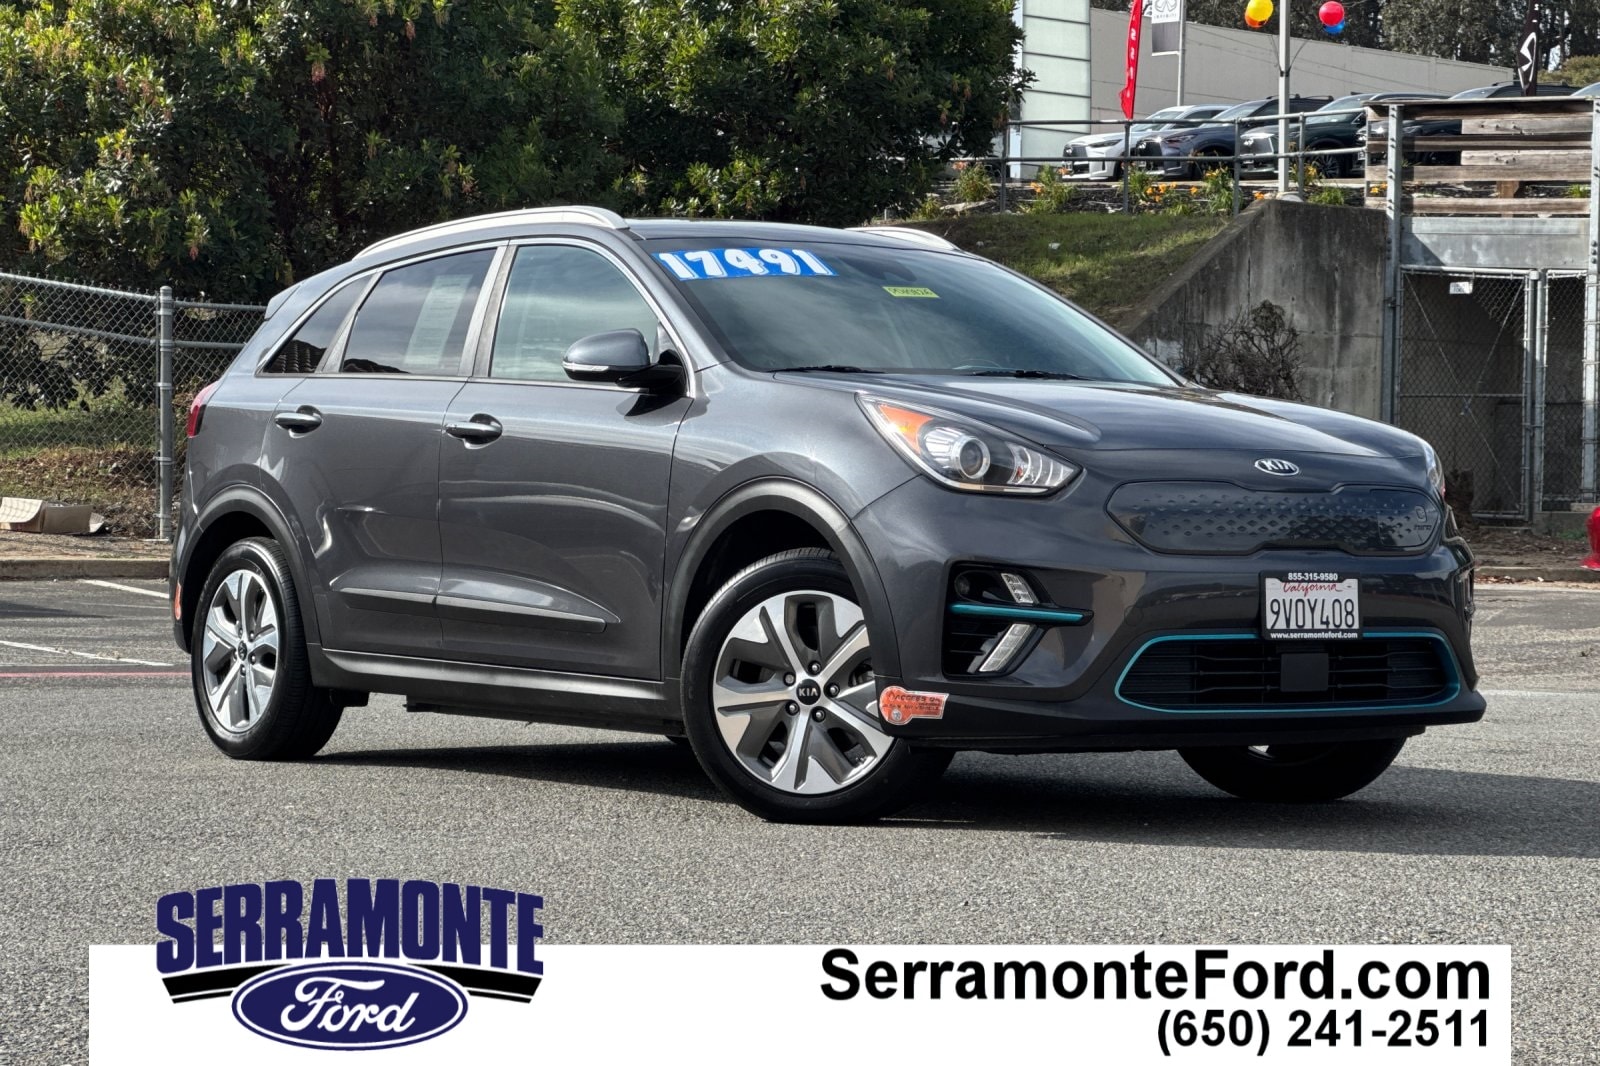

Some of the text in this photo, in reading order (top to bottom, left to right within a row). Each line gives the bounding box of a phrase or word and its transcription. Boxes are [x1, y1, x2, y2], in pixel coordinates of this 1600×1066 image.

[659, 249, 833, 279] 17491
[1287, 572, 1338, 581] 855-315-9580
[1281, 582, 1343, 597] California
[1270, 631, 1358, 639] www.serramonteford.com
[798, 687, 818, 697] KIA
